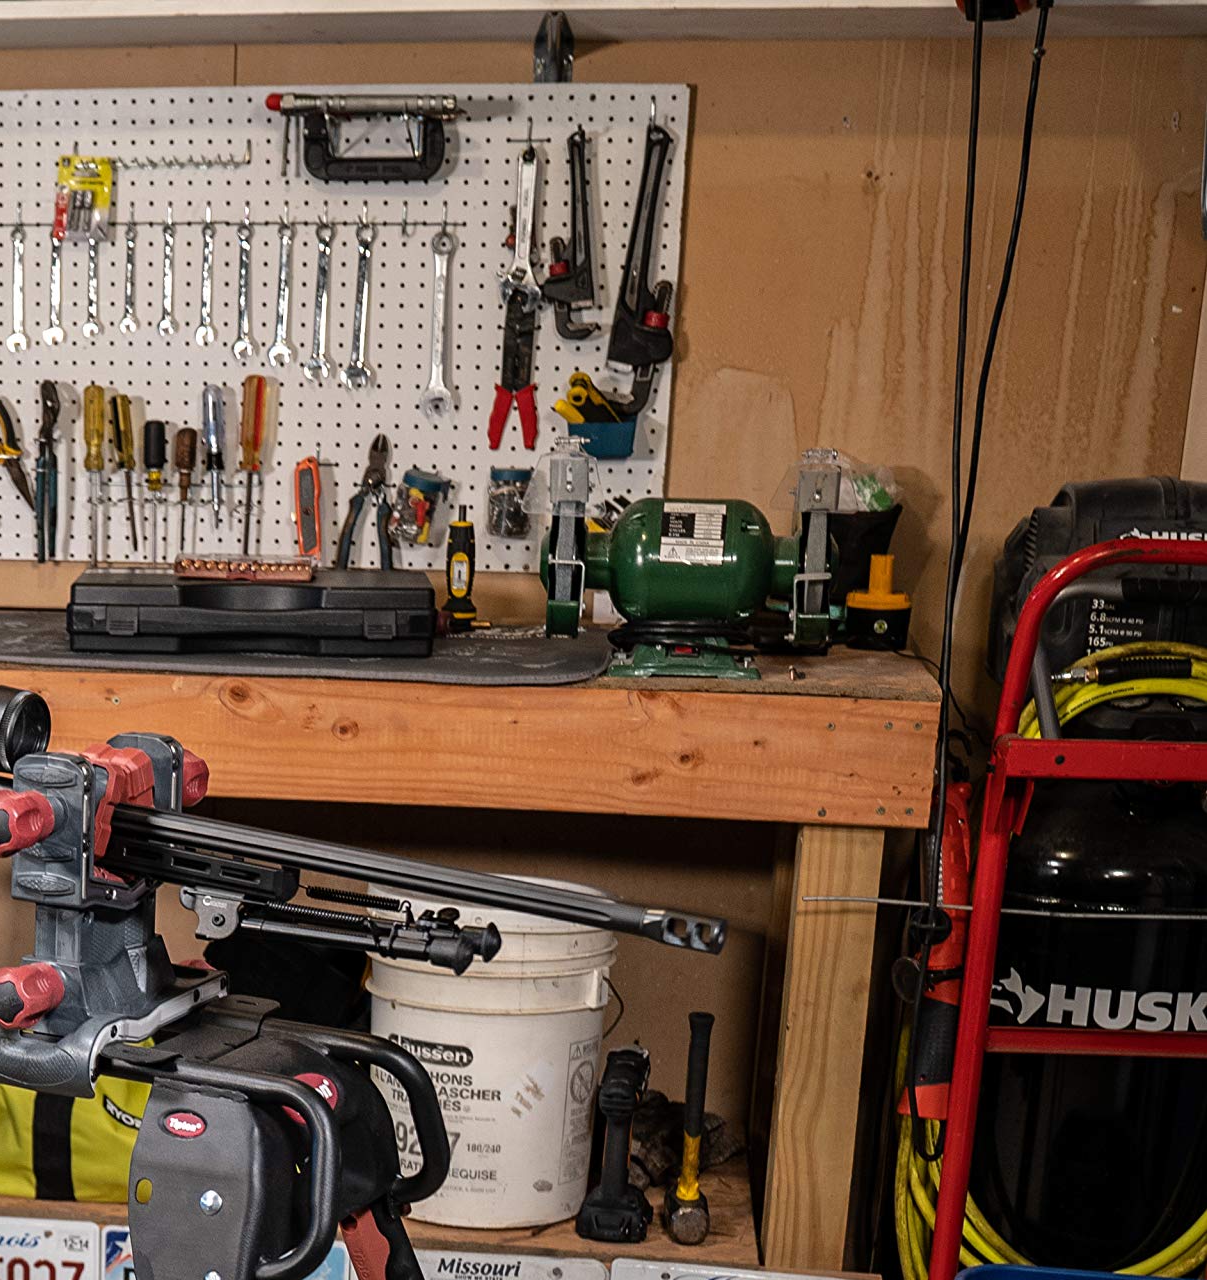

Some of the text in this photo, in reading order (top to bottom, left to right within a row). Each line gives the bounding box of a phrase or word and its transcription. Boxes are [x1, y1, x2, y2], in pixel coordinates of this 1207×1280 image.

[391, 1034, 468, 1064] laussen
[447, 1167, 497, 1180] EQUISE
[437, 1258, 522, 1278] Missouri
